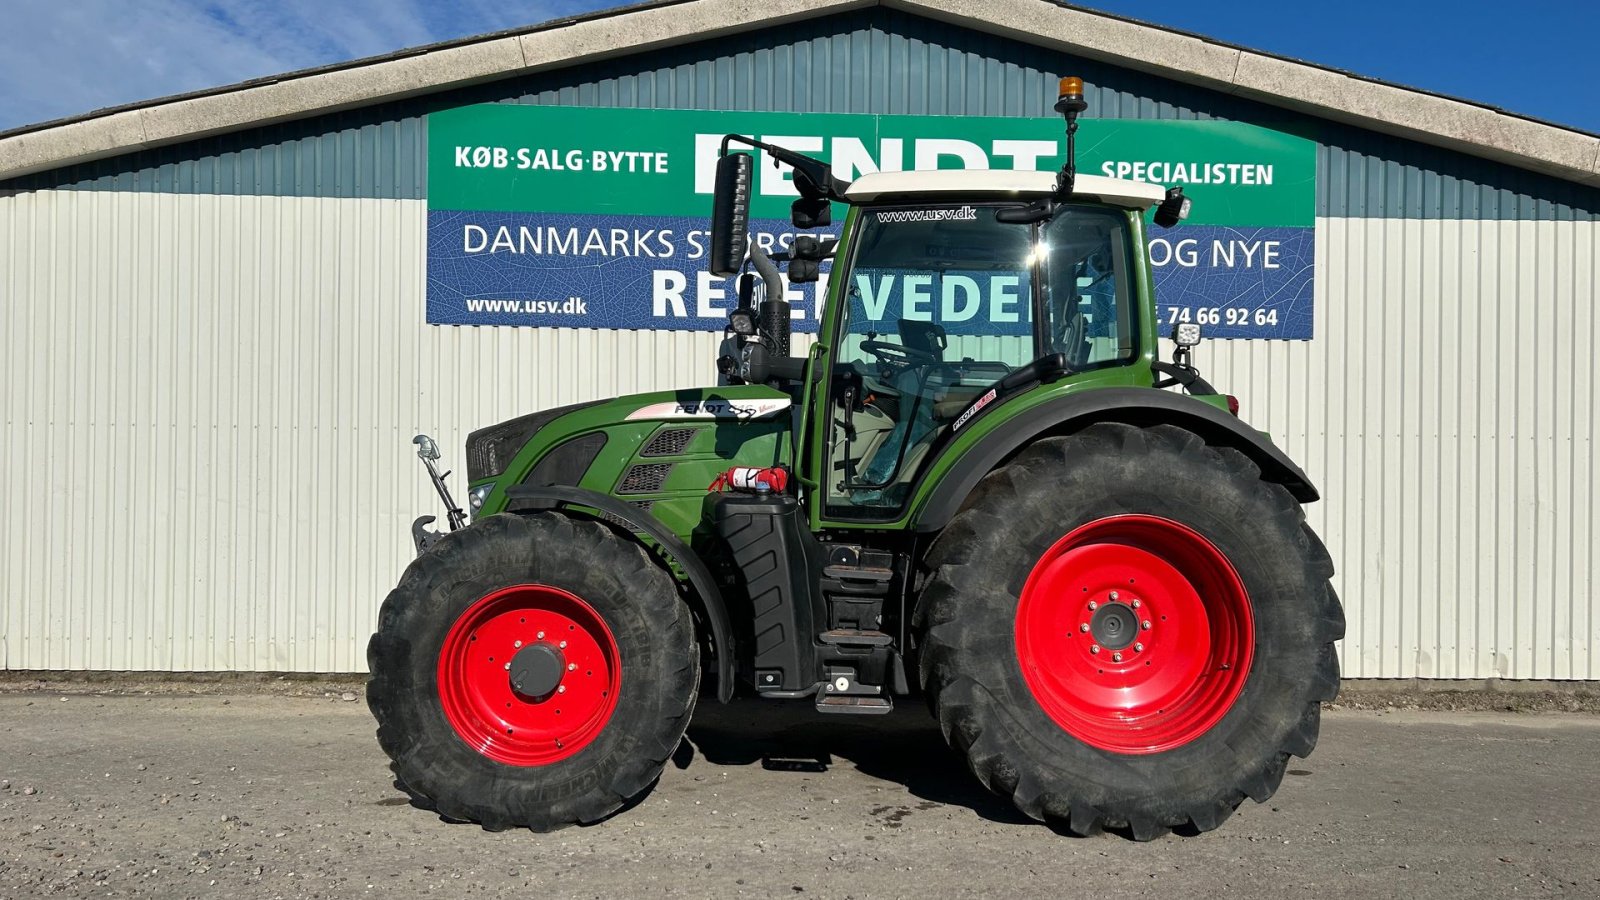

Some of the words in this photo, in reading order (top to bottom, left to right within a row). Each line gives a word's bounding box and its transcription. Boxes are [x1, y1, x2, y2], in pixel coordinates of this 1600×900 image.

[1101, 161, 1273, 185] SPECIALISTEN
[877, 206, 977, 222] www.usv.dk
[464, 225, 675, 258] DANMARKS
[1149, 238, 1198, 267] OG
[1213, 239, 1280, 269] NYE
[467, 297, 587, 315] www.usv.dk
[1168, 307, 1191, 324] 74
[1197, 308, 1219, 325] 66
[1226, 308, 1249, 325] 92
[1255, 309, 1278, 326] 64
[675, 404, 725, 415] FENDT
